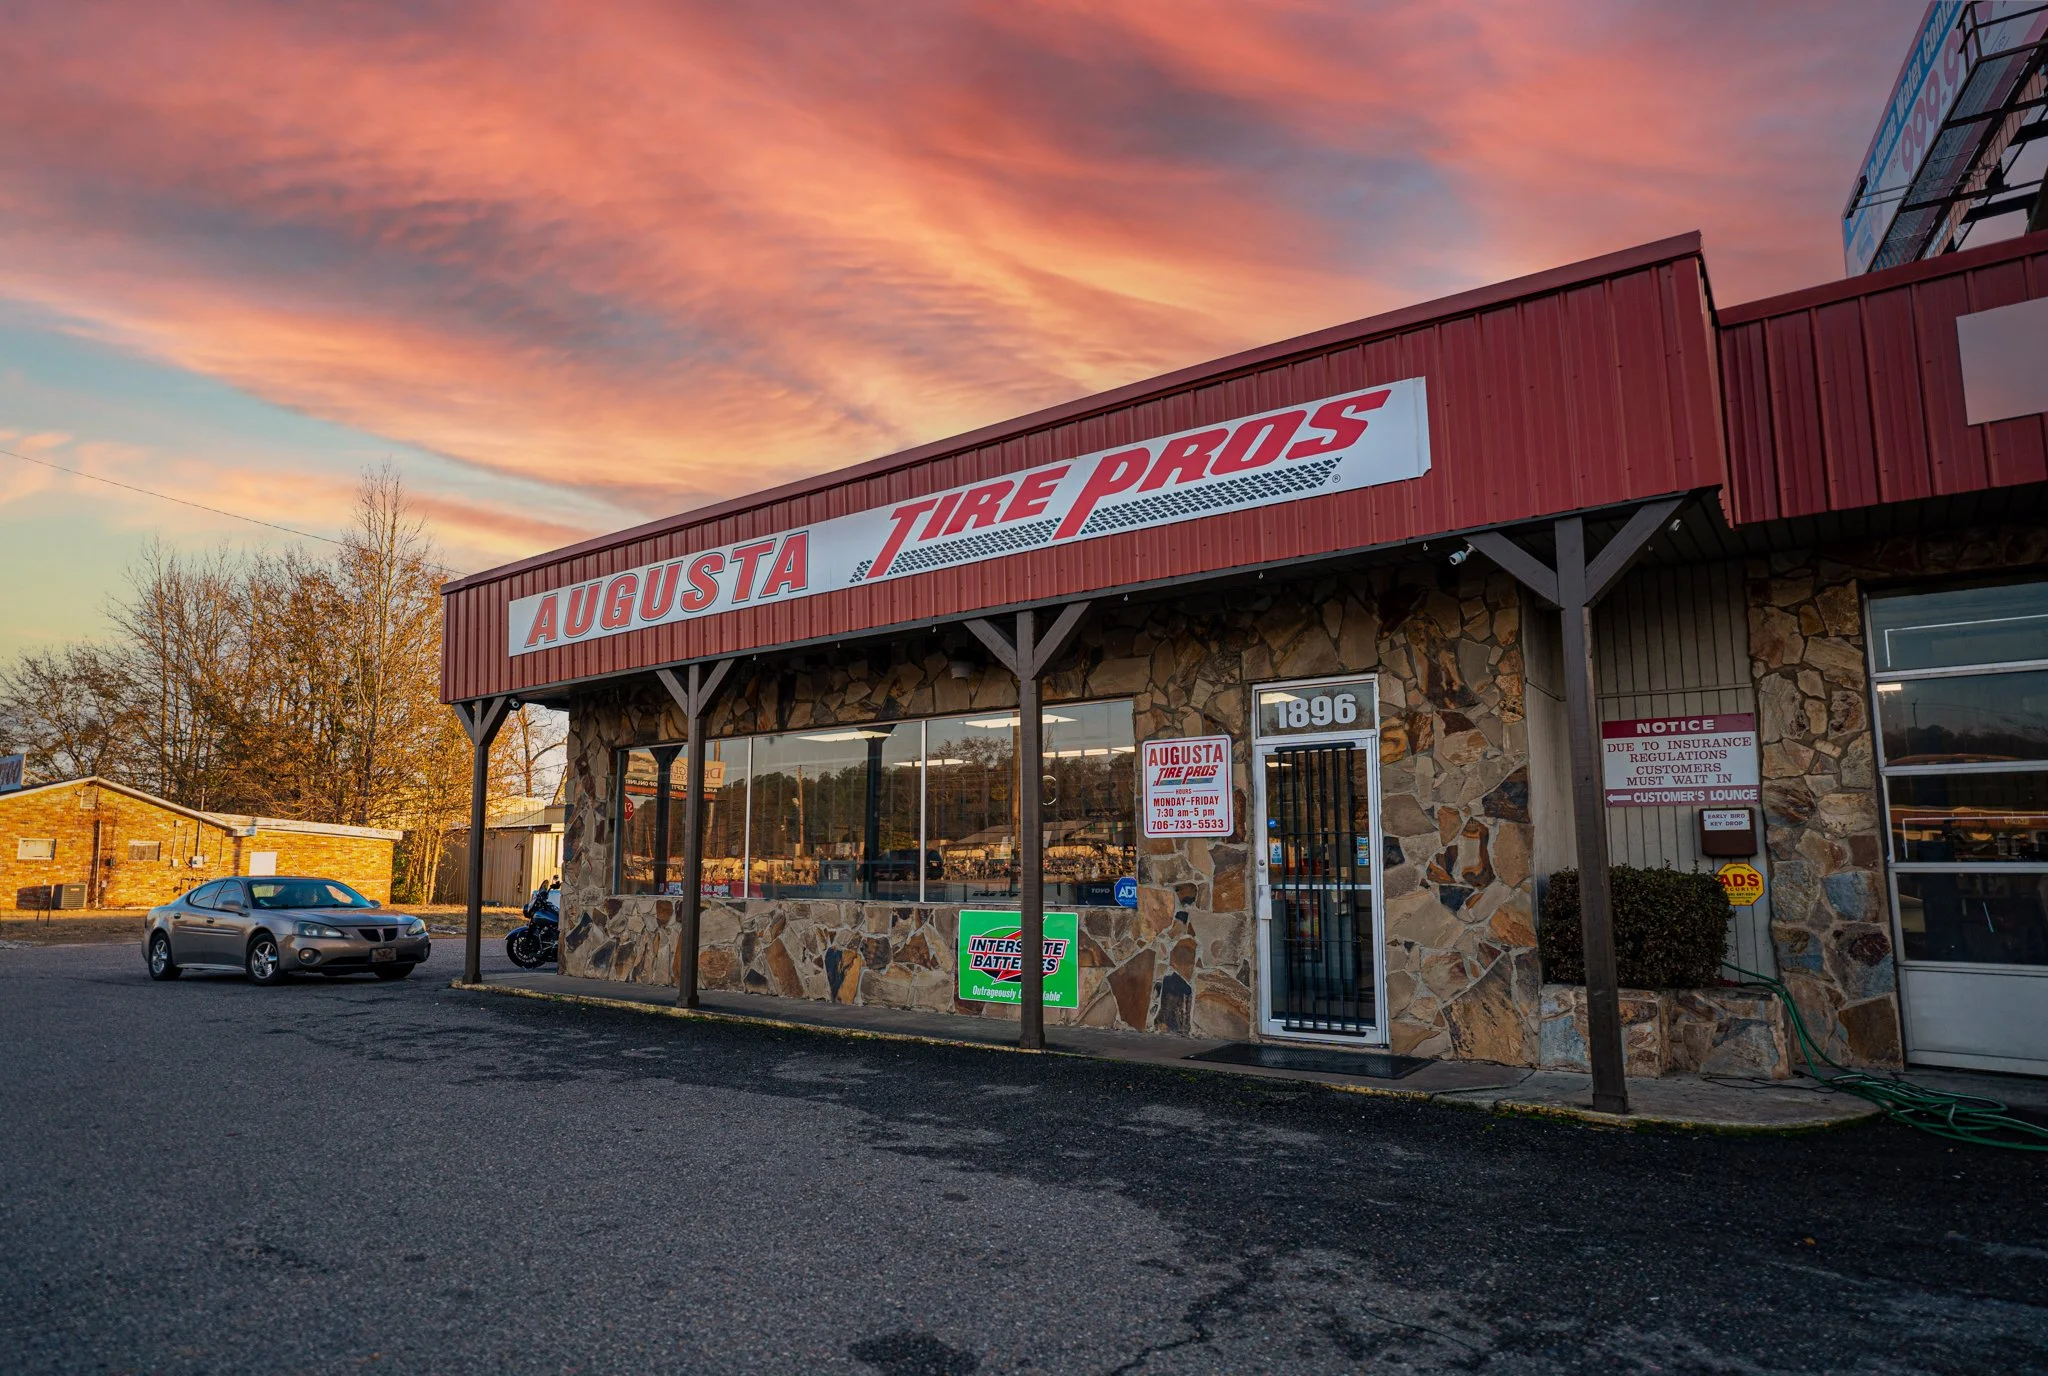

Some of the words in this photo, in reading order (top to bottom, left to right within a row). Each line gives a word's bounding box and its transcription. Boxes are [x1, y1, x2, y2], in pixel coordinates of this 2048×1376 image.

[1895, 57, 1921, 120] Water
[524, 530, 809, 648] AUGUSTA
[866, 465, 1072, 579] TIRE
[1052, 389, 1391, 540] PROS
[1275, 693, 1357, 729] 1896
[1636, 719, 1715, 734] NOTICE
[1607, 742, 1635, 753] DUE
[1642, 742, 1659, 751] TO
[1667, 737, 1751, 750] INSURANCE
[1148, 743, 1223, 767] AUGUSTA
[1630, 750, 1728, 763] REGULATIONS
[1155, 766, 1184, 786] TIRE
[1181, 765, 1219, 785] PROS
[1636, 763, 1721, 775] CUSTOMERS
[1626, 776, 1664, 786] MUST
[1672, 775, 1708, 785] WAIT
[1716, 774, 1732, 784] IN
[1153, 795, 1219, 807] MONDAY-FRIDAY
[1633, 790, 1706, 803] CUSTOMER'S
[1710, 789, 1758, 801] LOUNGE
[1156, 808, 1174, 817] 7:30
[1203, 808, 1215, 817] pm
[1152, 818, 1224, 830] 706-733-5533
[1719, 873, 1759, 887] ADS
[1118, 886, 1137, 898] ADT
[971, 939, 1064, 955] INTERSTE
[972, 985, 1016, 1000] Outrageously
